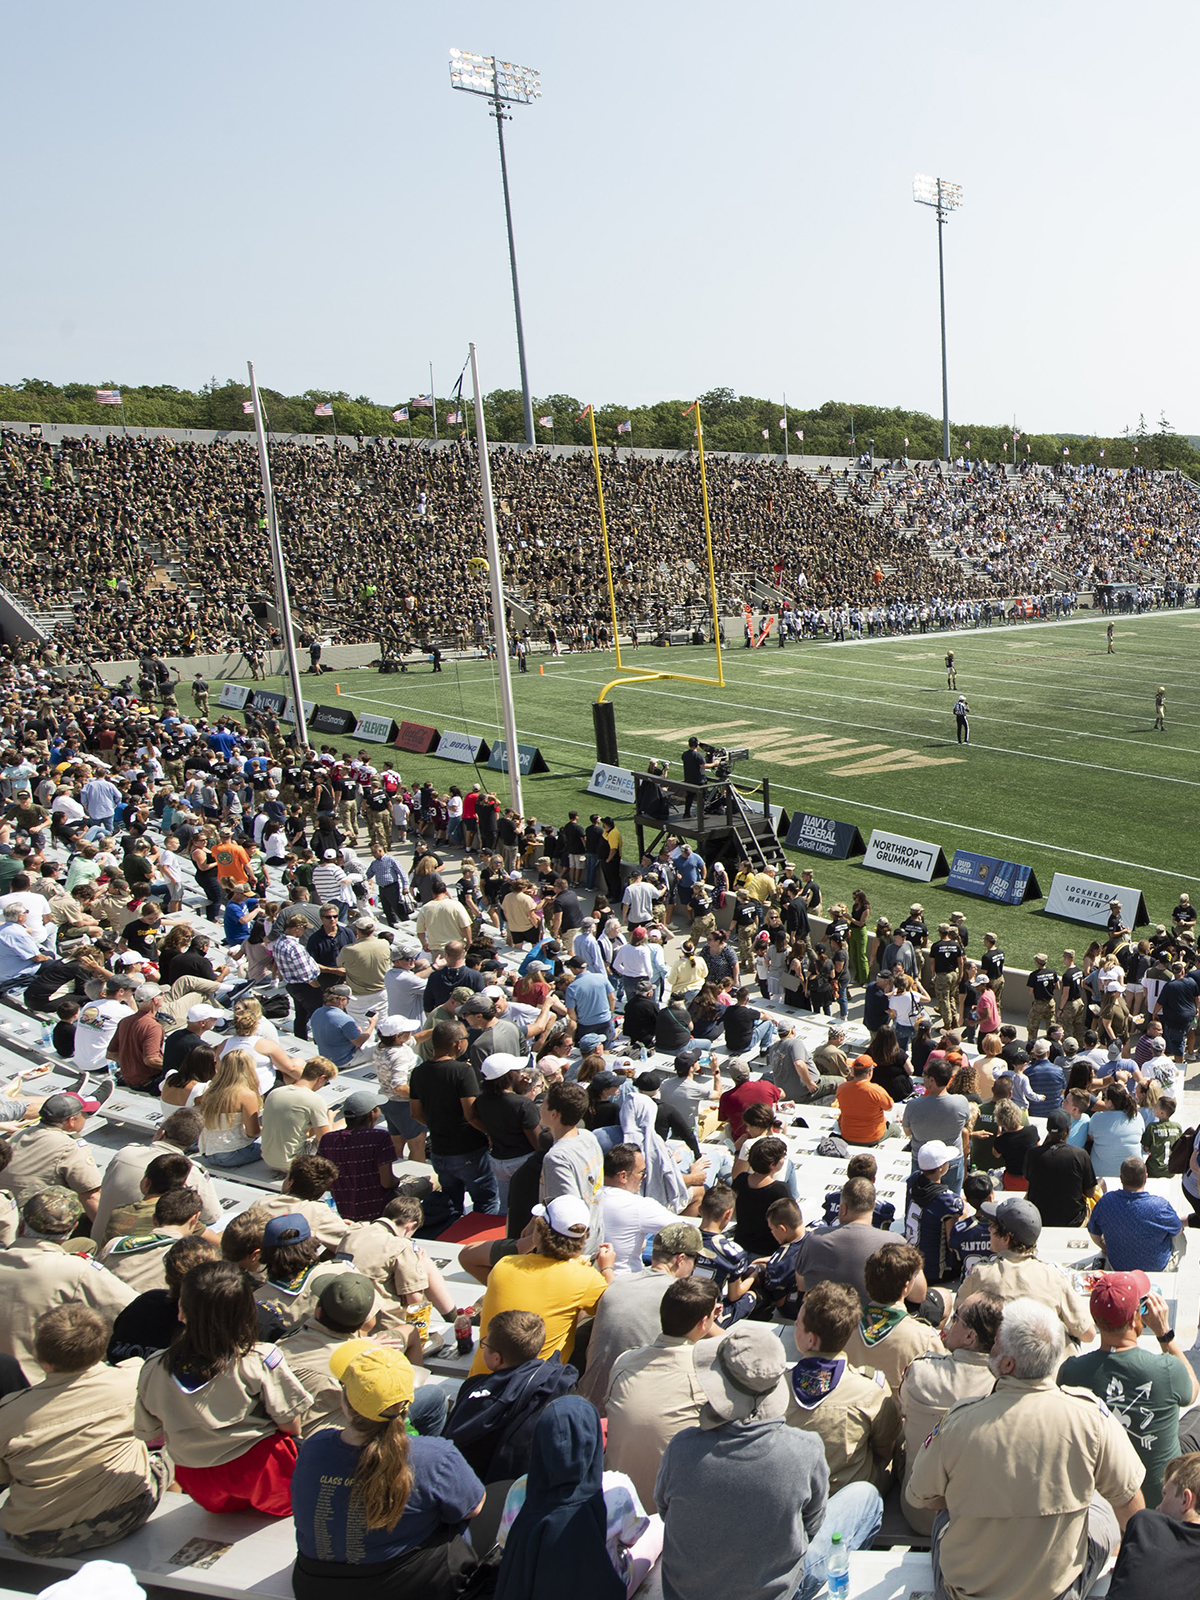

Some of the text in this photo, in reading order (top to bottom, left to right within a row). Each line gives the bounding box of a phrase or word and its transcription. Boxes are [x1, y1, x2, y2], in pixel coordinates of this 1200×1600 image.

[261, 697, 279, 713] USAA
[357, 720, 389, 737] 7-ELEVEN
[449, 741, 478, 753] BOEING
[604, 784, 619, 793] CREDIT
[803, 815, 826, 829] NAVY
[800, 824, 837, 843] FEDERAL
[797, 838, 834, 855] Credit Union
[872, 838, 920, 858] NORTHROP
[876, 850, 923, 870] GRUMMAN
[957, 859, 971, 868] BUD
[953, 865, 973, 876] LIGHT
[993, 875, 1010, 890] BUD
[1065, 885, 1109, 901] LOCKHEED
[1067, 895, 1102, 909] MARTIN
[320, 1475, 343, 1486] CLASS
[344, 1478, 355, 1487] OF
